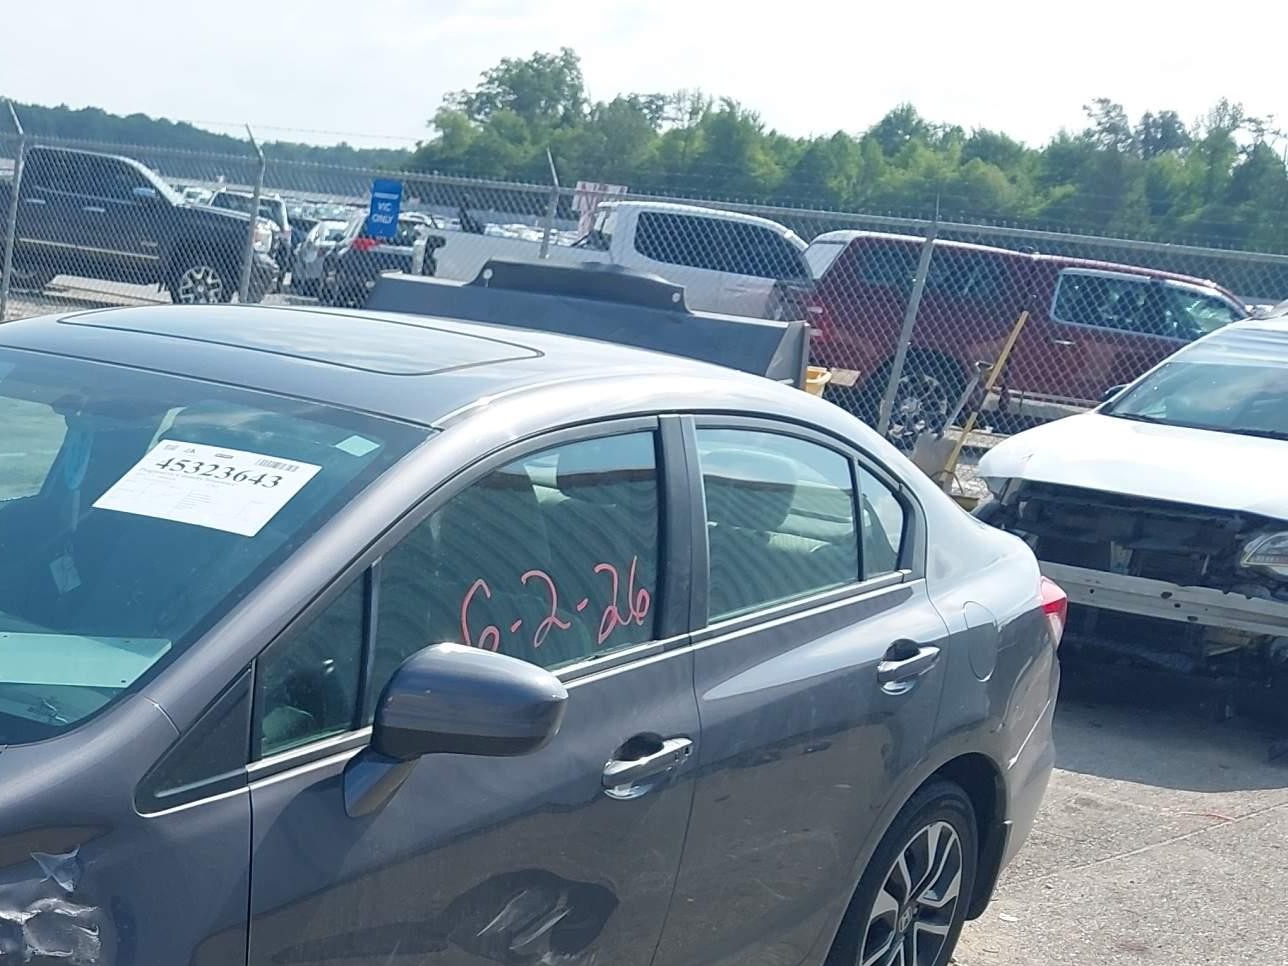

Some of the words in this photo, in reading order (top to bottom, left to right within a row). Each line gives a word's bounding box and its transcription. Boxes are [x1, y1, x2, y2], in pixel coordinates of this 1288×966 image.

[372, 214, 394, 224] ONLY
[155, 457, 283, 489] 45323643
[461, 555, 650, 652] 6-2-26
